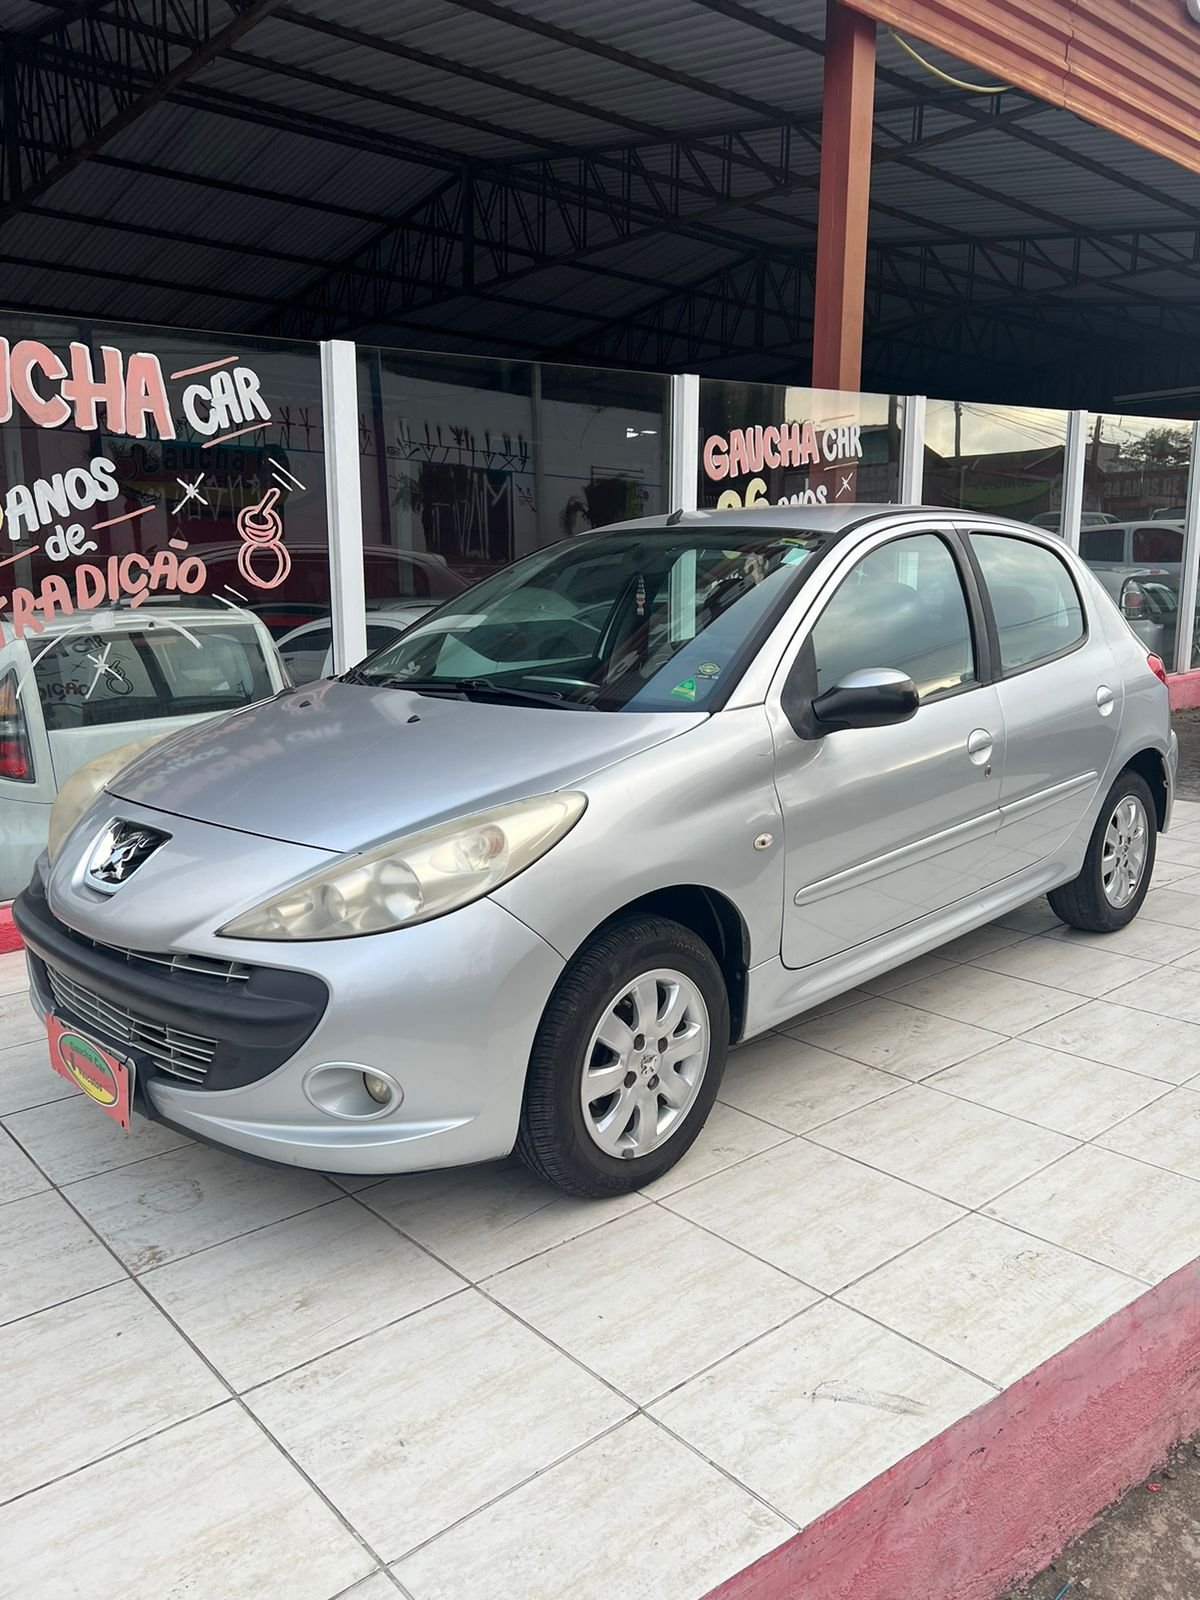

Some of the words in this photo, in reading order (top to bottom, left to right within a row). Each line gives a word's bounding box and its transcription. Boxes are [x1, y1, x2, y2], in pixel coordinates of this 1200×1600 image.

[183, 367, 271, 435] CAR
[704, 420, 820, 481] GAUCHA
[822, 424, 863, 462] CAR
[5, 457, 119, 540] ANOS
[45, 523, 98, 561] de
